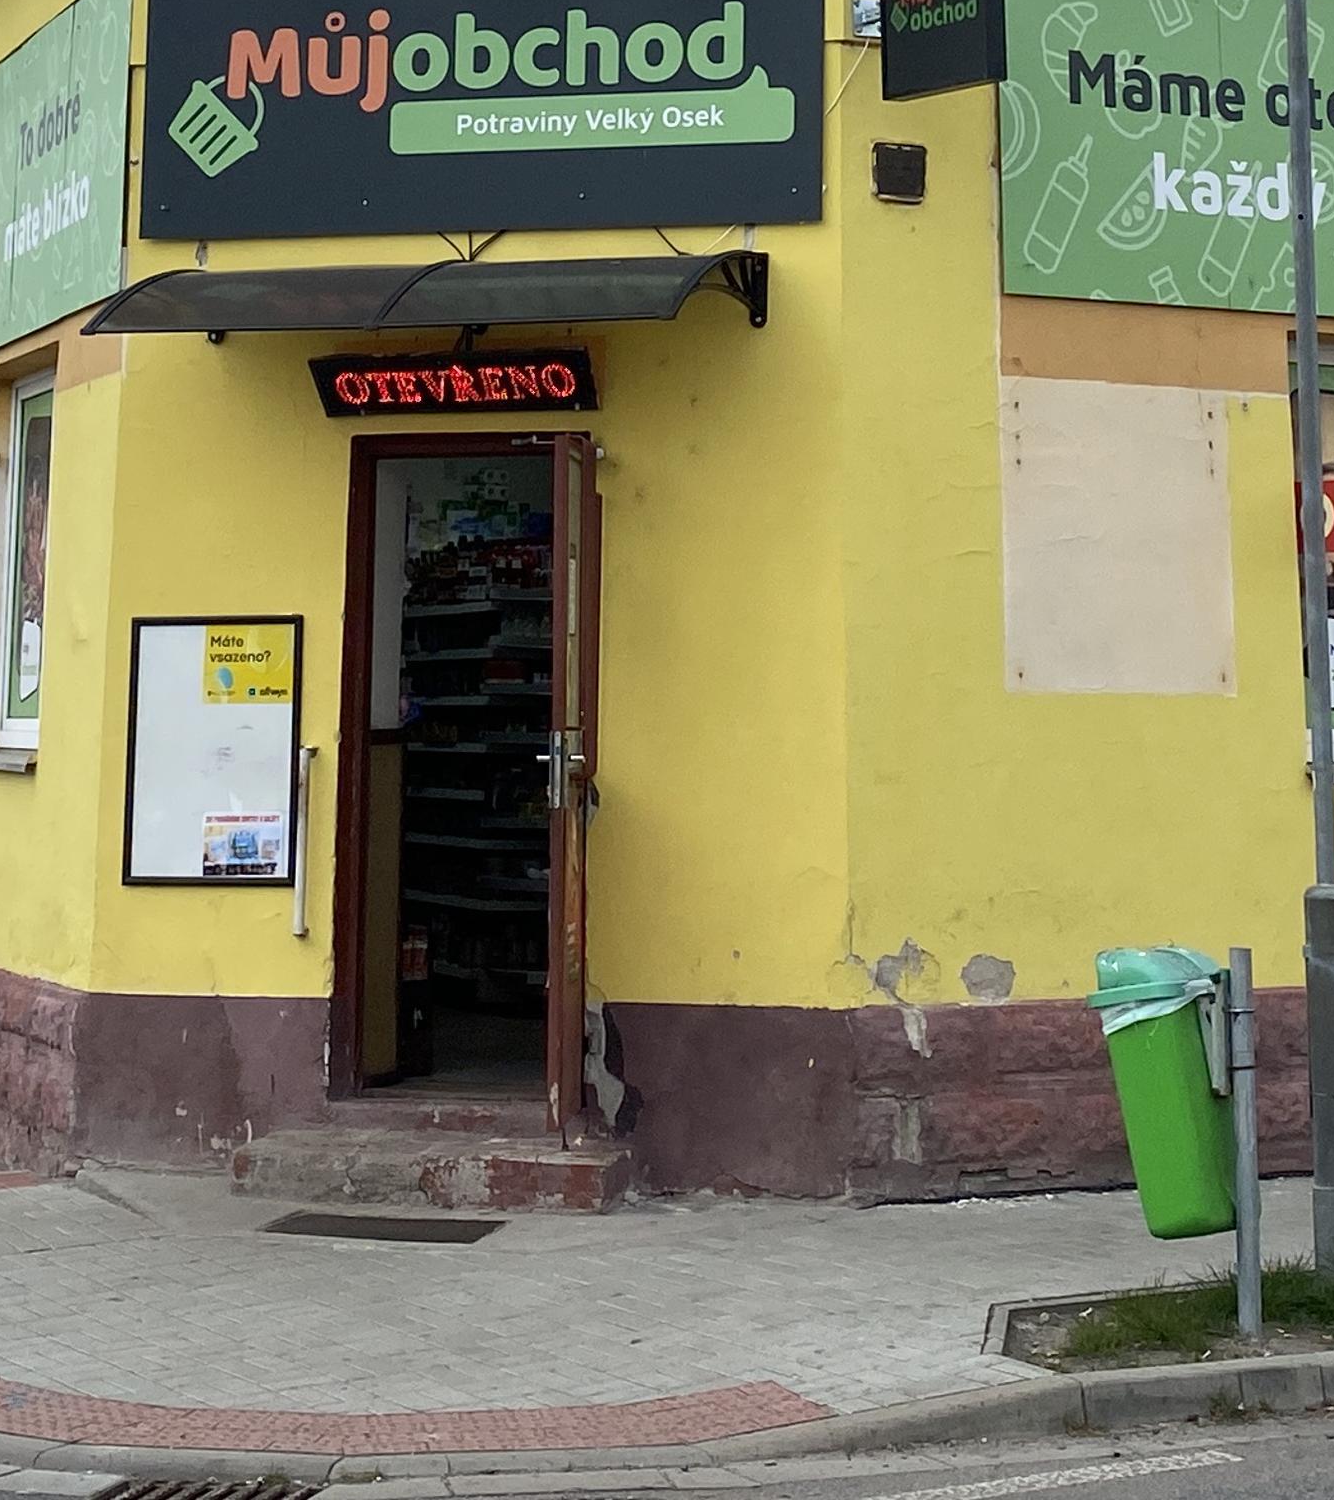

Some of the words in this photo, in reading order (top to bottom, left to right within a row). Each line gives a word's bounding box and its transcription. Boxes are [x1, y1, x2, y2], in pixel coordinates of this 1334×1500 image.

[1067, 49, 1245, 122] Máme
[20, 121, 34, 171] To
[37, 78, 81, 158] dobré
[456, 110, 577, 137] Potraviny
[585, 106, 654, 135] Velký
[662, 104, 725, 129] Osek
[3, 202, 40, 263] máte
[43, 170, 90, 241] blízko
[335, 363, 576, 404] OTEVŘENO
[209, 650, 272, 663] vsazeno?
[210, 634, 244, 647] Máte
